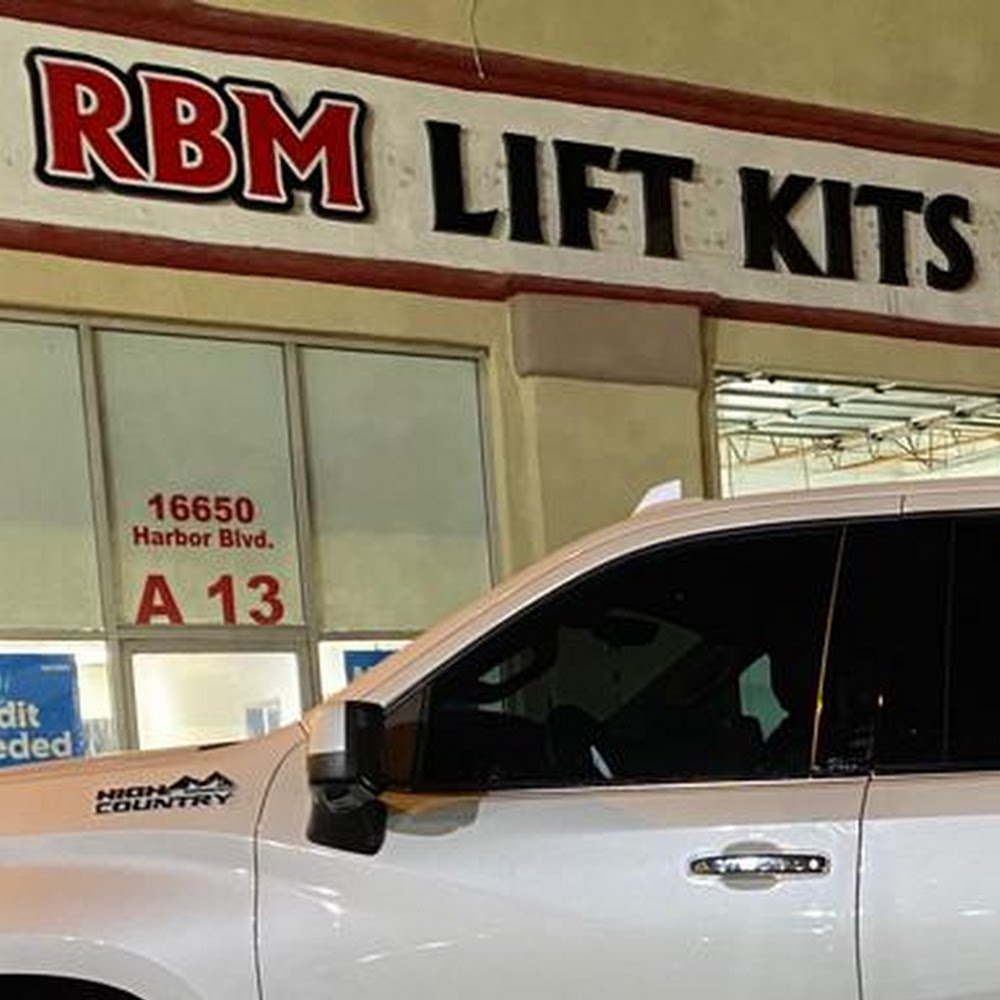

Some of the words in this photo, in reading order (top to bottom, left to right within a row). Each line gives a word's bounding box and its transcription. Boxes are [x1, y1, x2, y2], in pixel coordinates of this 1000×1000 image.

[26, 47, 372, 220] RBM
[425, 119, 695, 260] LIFT
[738, 167, 976, 292] KITS
[147, 493, 255, 523] 16650
[132, 526, 211, 547] Harbor
[219, 528, 275, 549] Blvd.
[135, 575, 185, 625] A
[207, 574, 285, 626] 13
[96, 792, 233, 814] COUNTRY
[97, 784, 168, 801] HIGH
